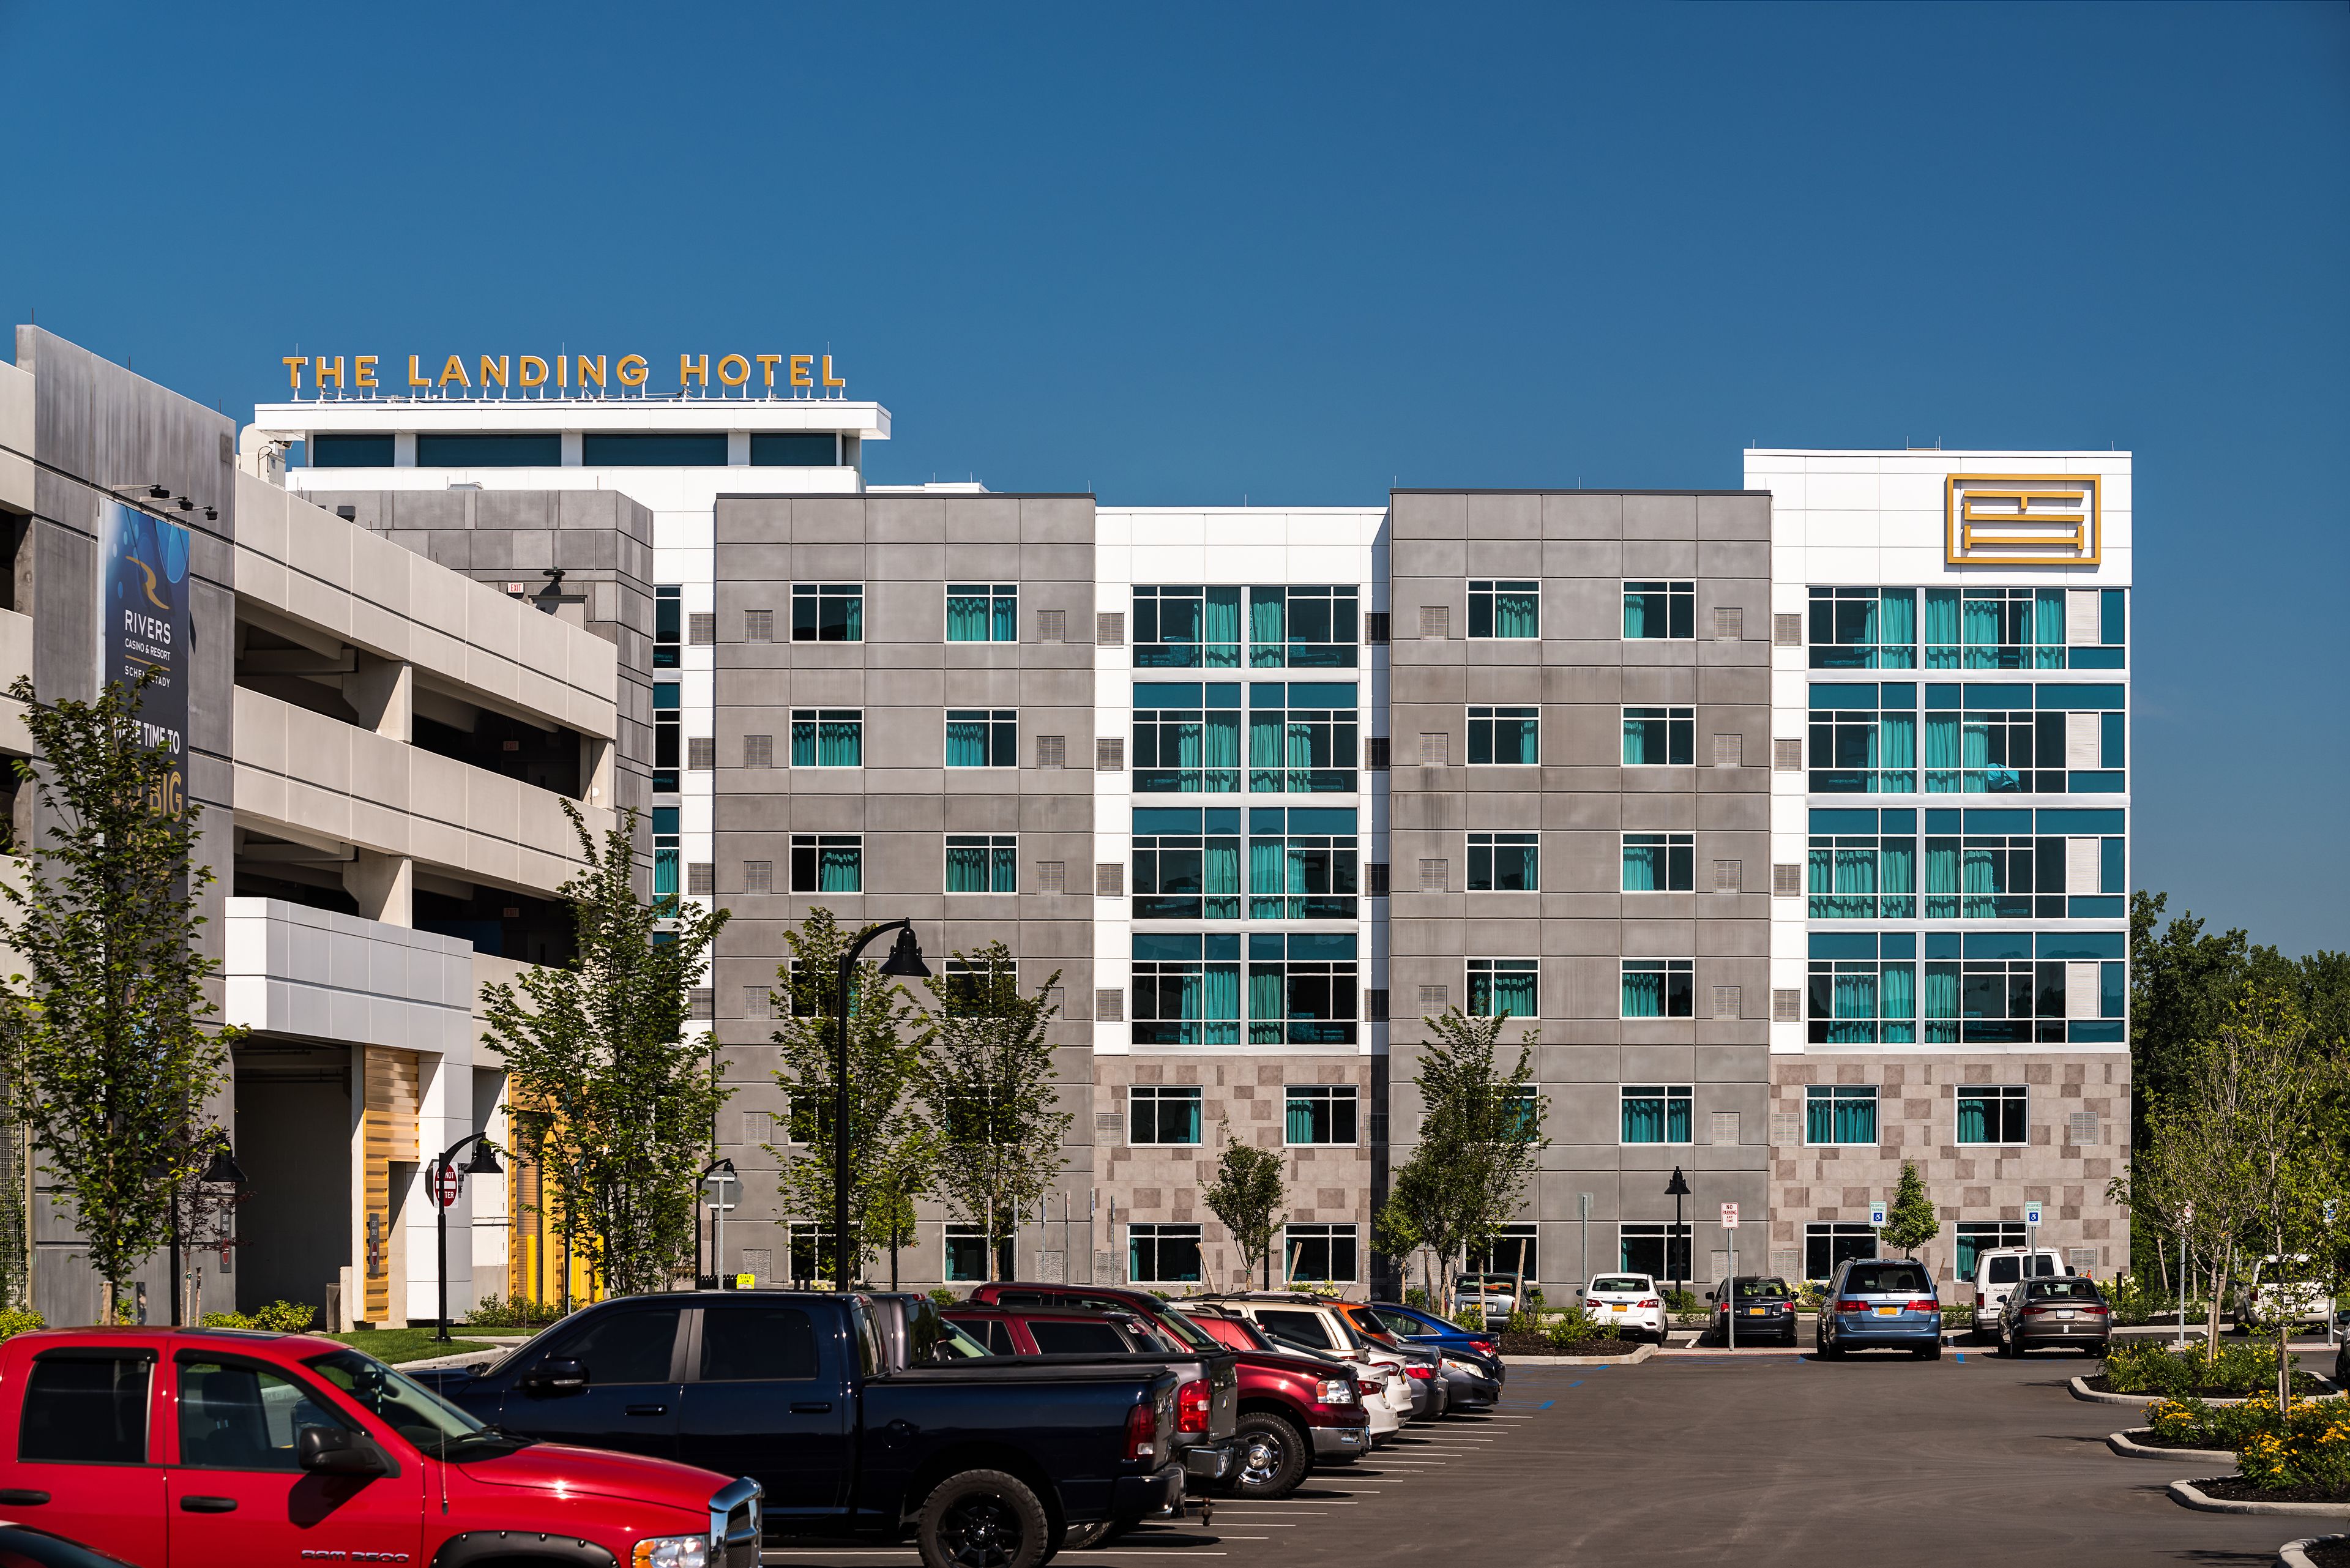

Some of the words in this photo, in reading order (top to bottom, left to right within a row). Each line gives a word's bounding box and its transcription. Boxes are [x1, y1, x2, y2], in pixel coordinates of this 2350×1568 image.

[283, 355, 379, 389] THE
[409, 354, 649, 388] LANDING
[680, 354, 846, 387] HOTEL
[125, 609, 171, 644] RIVERS
[125, 638, 144, 653] CASINO
[145, 644, 150, 654] &
[150, 646, 171, 661] RESORT
[125, 665, 170, 688] SCHENTADY
[143, 722, 165, 748] TIME
[167, 729, 180, 755] TO
[149, 769, 182, 823] BIG
[301, 1550, 346, 1561] RAM
[351, 1551, 409, 1564] 2500
